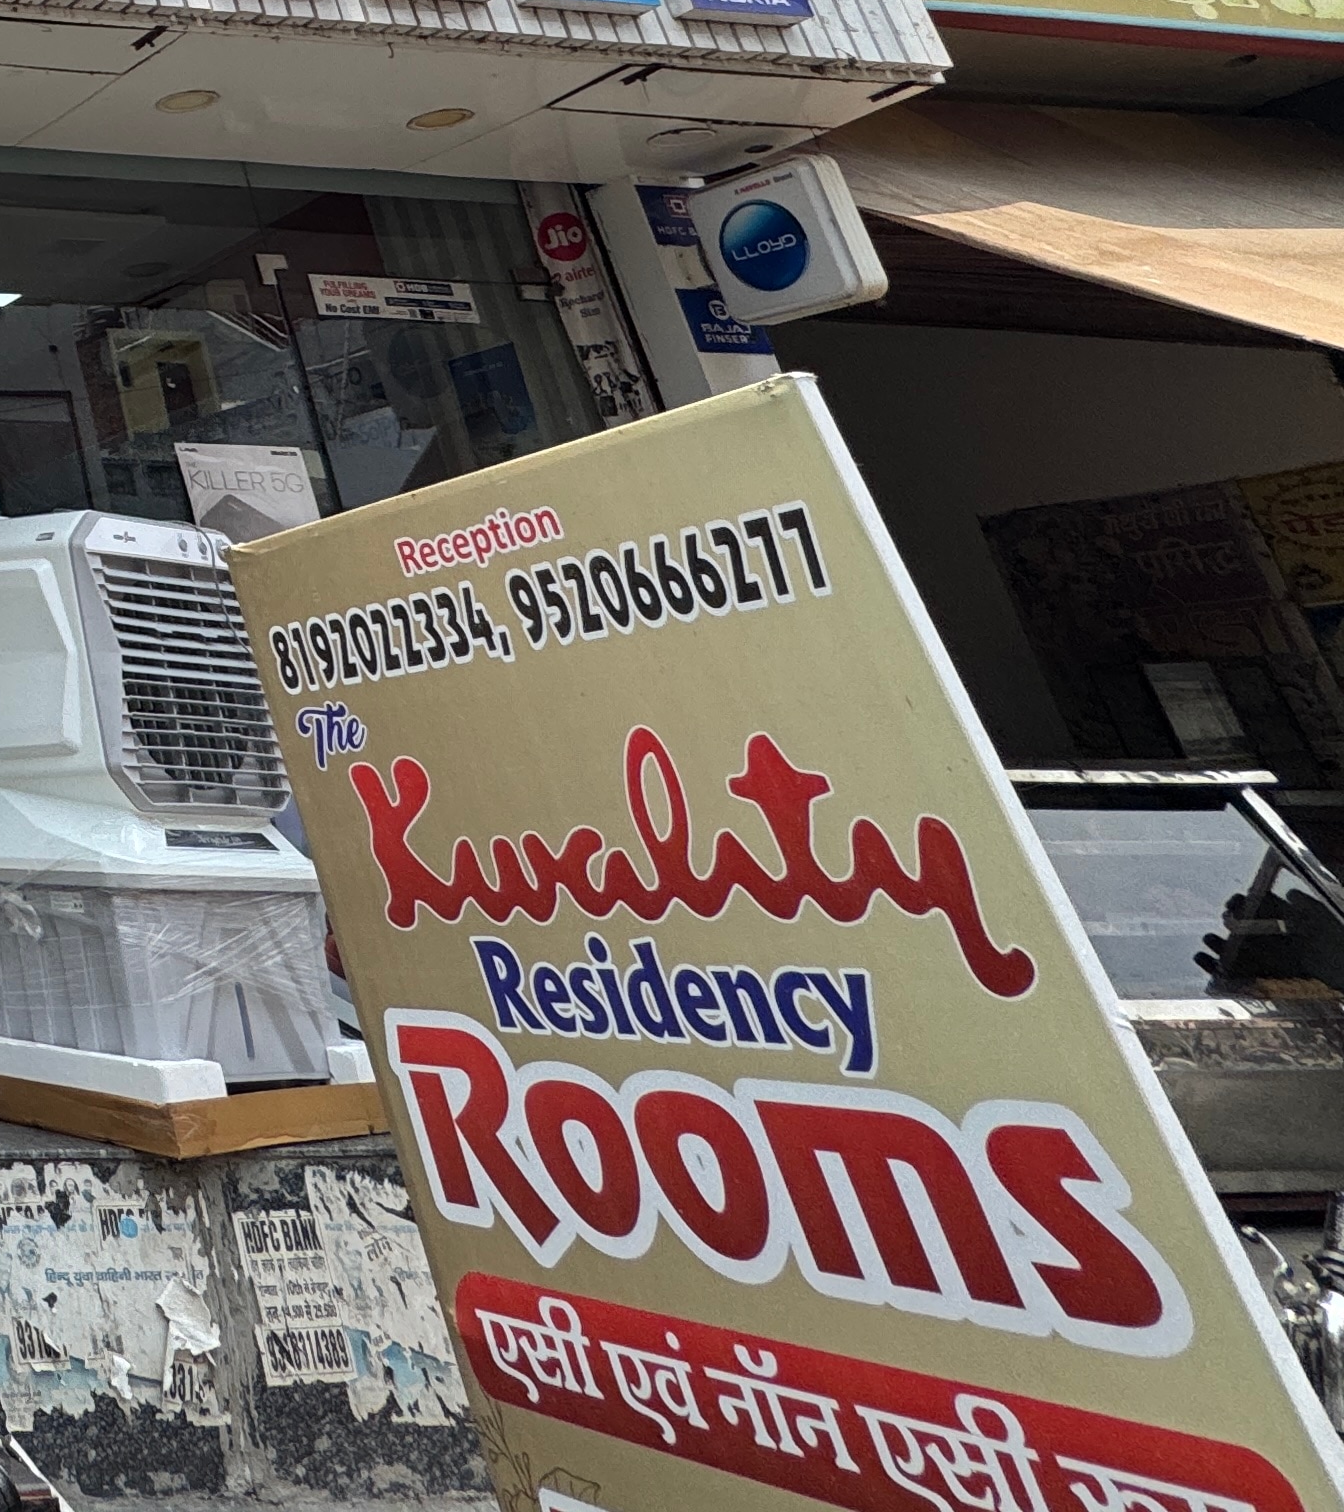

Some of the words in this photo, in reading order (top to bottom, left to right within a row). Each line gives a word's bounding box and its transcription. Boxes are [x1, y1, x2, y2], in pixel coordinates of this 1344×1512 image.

[545, 224, 583, 250] Jio
[731, 233, 797, 262] LLOYD
[701, 322, 752, 335] BAJAJ
[705, 333, 750, 345] FINSER
[188, 469, 267, 492] KILLER
[270, 472, 304, 493] 5G
[396, 506, 563, 576] Reception
[269, 581, 514, 695] 8192022334,
[505, 501, 833, 649] 9520666277
[297, 701, 366, 770] The
[348, 725, 1041, 1000] Kwality
[469, 932, 879, 1078] Residency
[241, 1219, 282, 1255] HDFC
[280, 1216, 325, 1253] BANK
[44, 1267, 72, 1286] हिन्दू
[73, 1271, 94, 1287] युवा
[474, 1296, 602, 1405] एसी
[600, 1336, 710, 1447] एवं
[704, 1345, 855, 1472] नॉन
